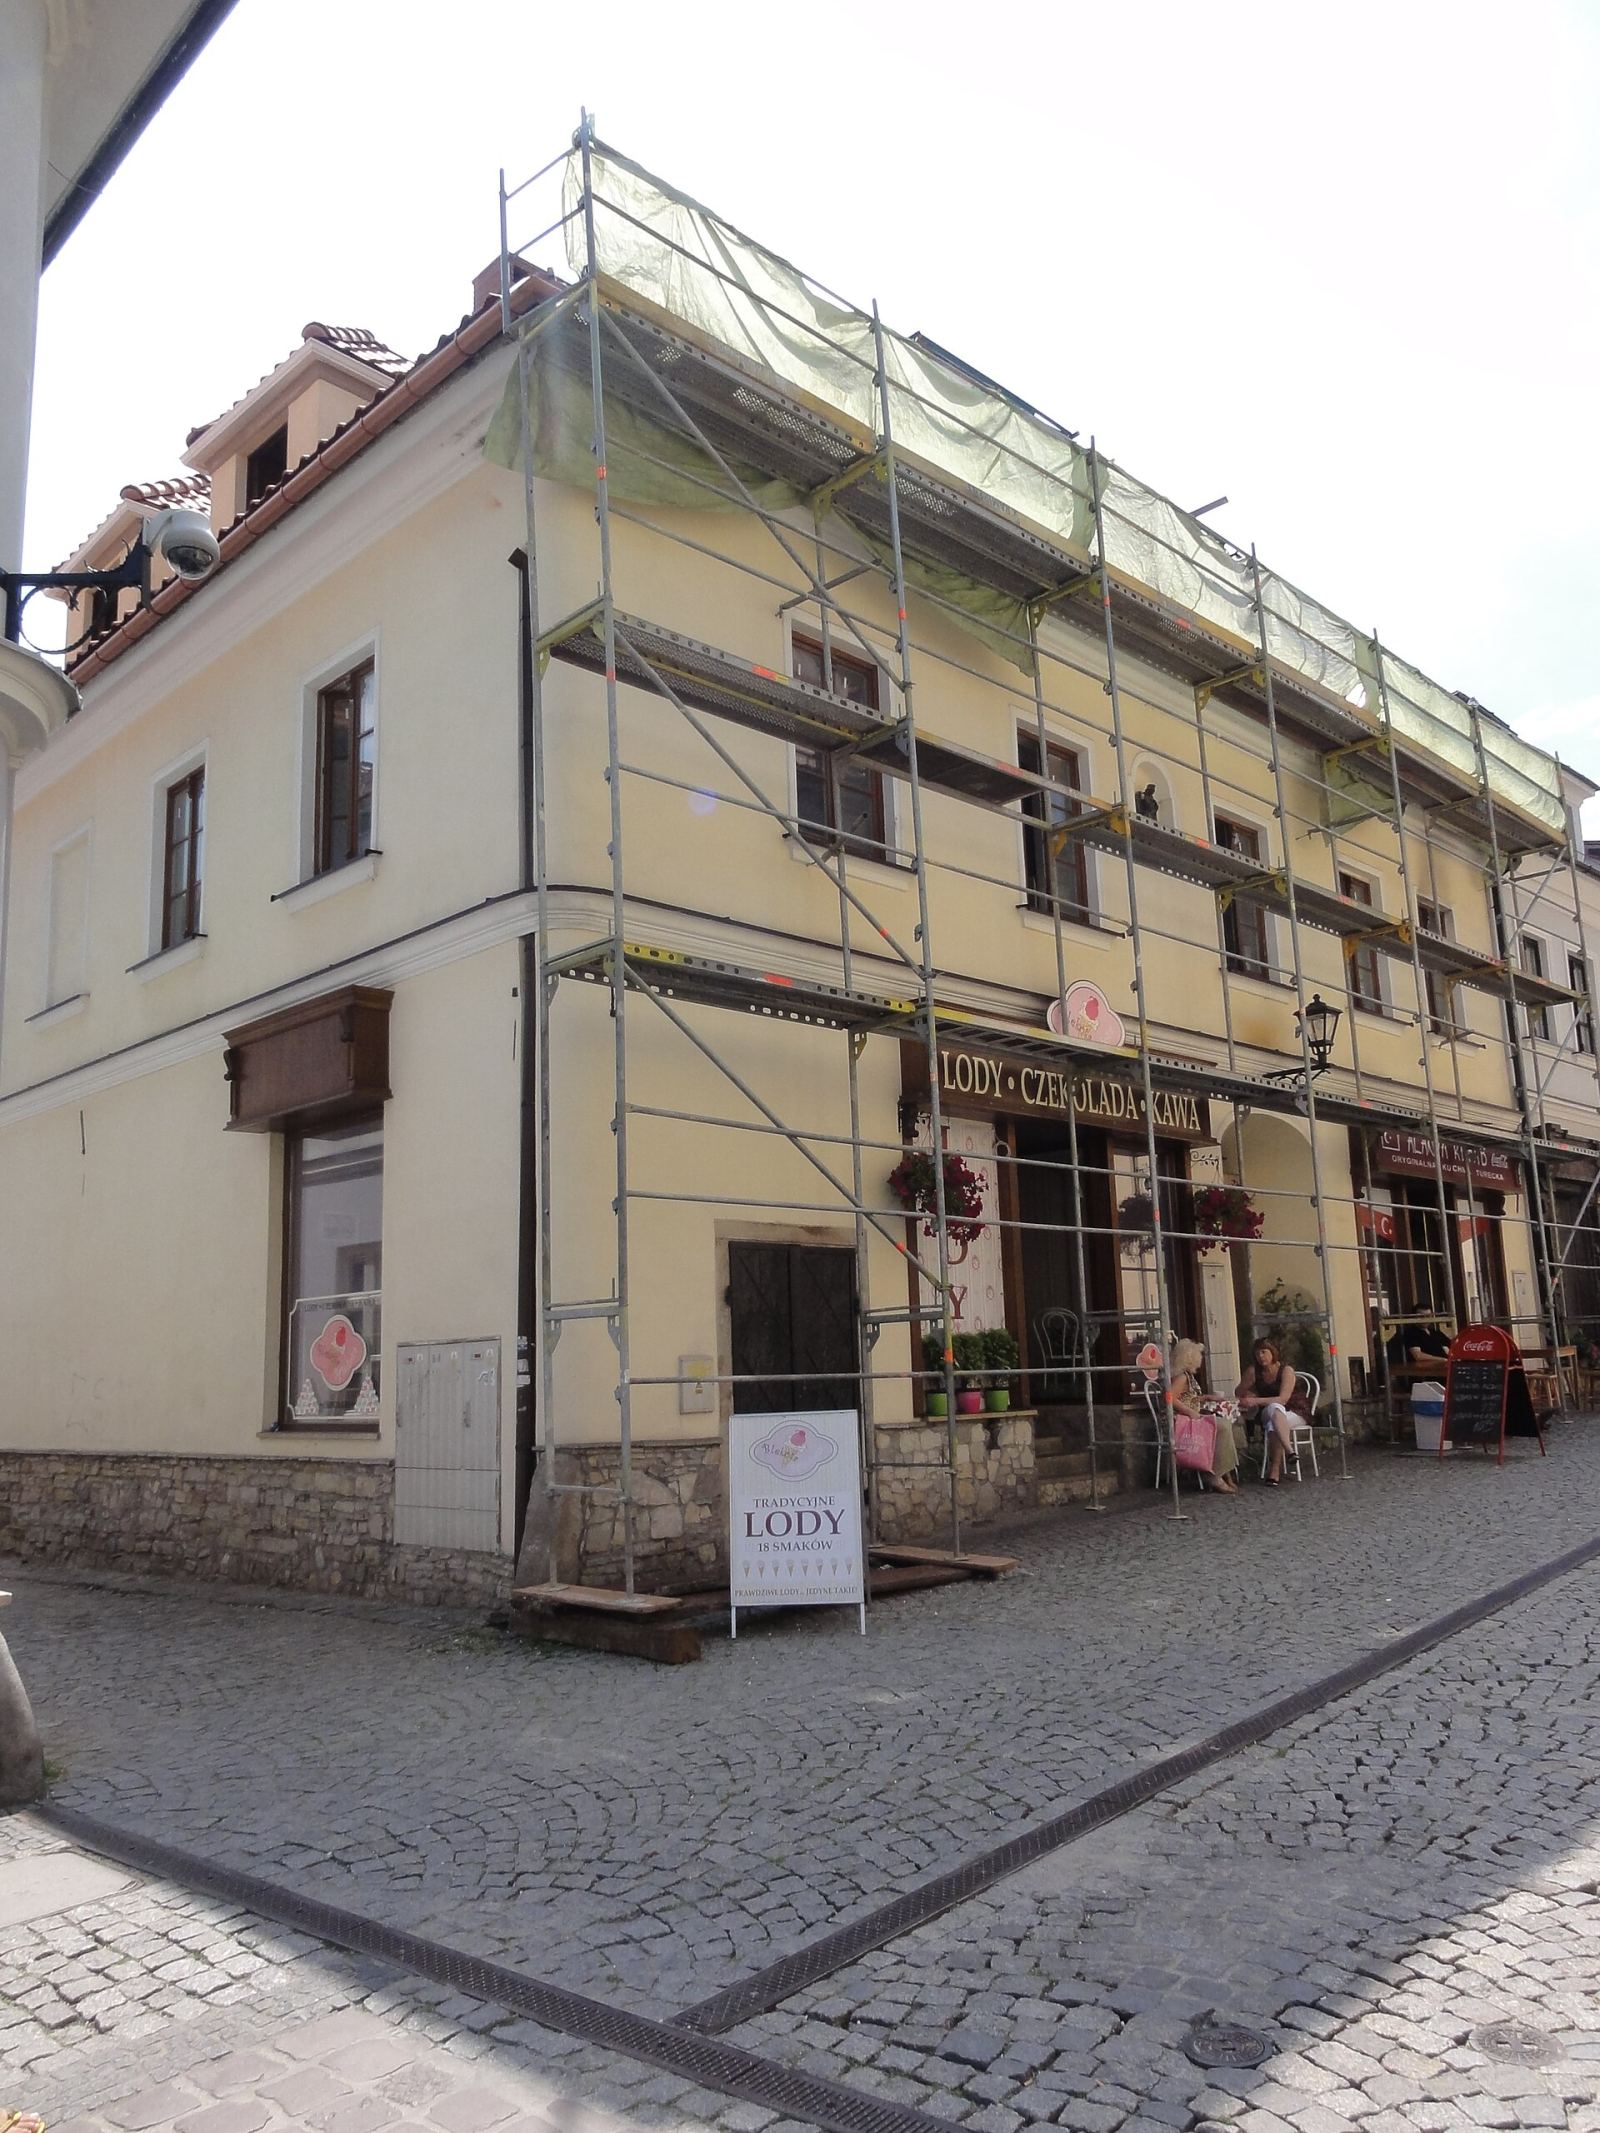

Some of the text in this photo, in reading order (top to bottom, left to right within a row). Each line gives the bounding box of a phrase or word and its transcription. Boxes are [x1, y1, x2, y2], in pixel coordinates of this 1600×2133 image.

[941, 1050, 1003, 1098] LODY
[1151, 1090, 1201, 1131] KAWA
[753, 1496, 836, 1508] TRADYCYJNE
[743, 1509, 845, 1538] LODY
[759, 1539, 833, 1552] 18 SMAKÓW
